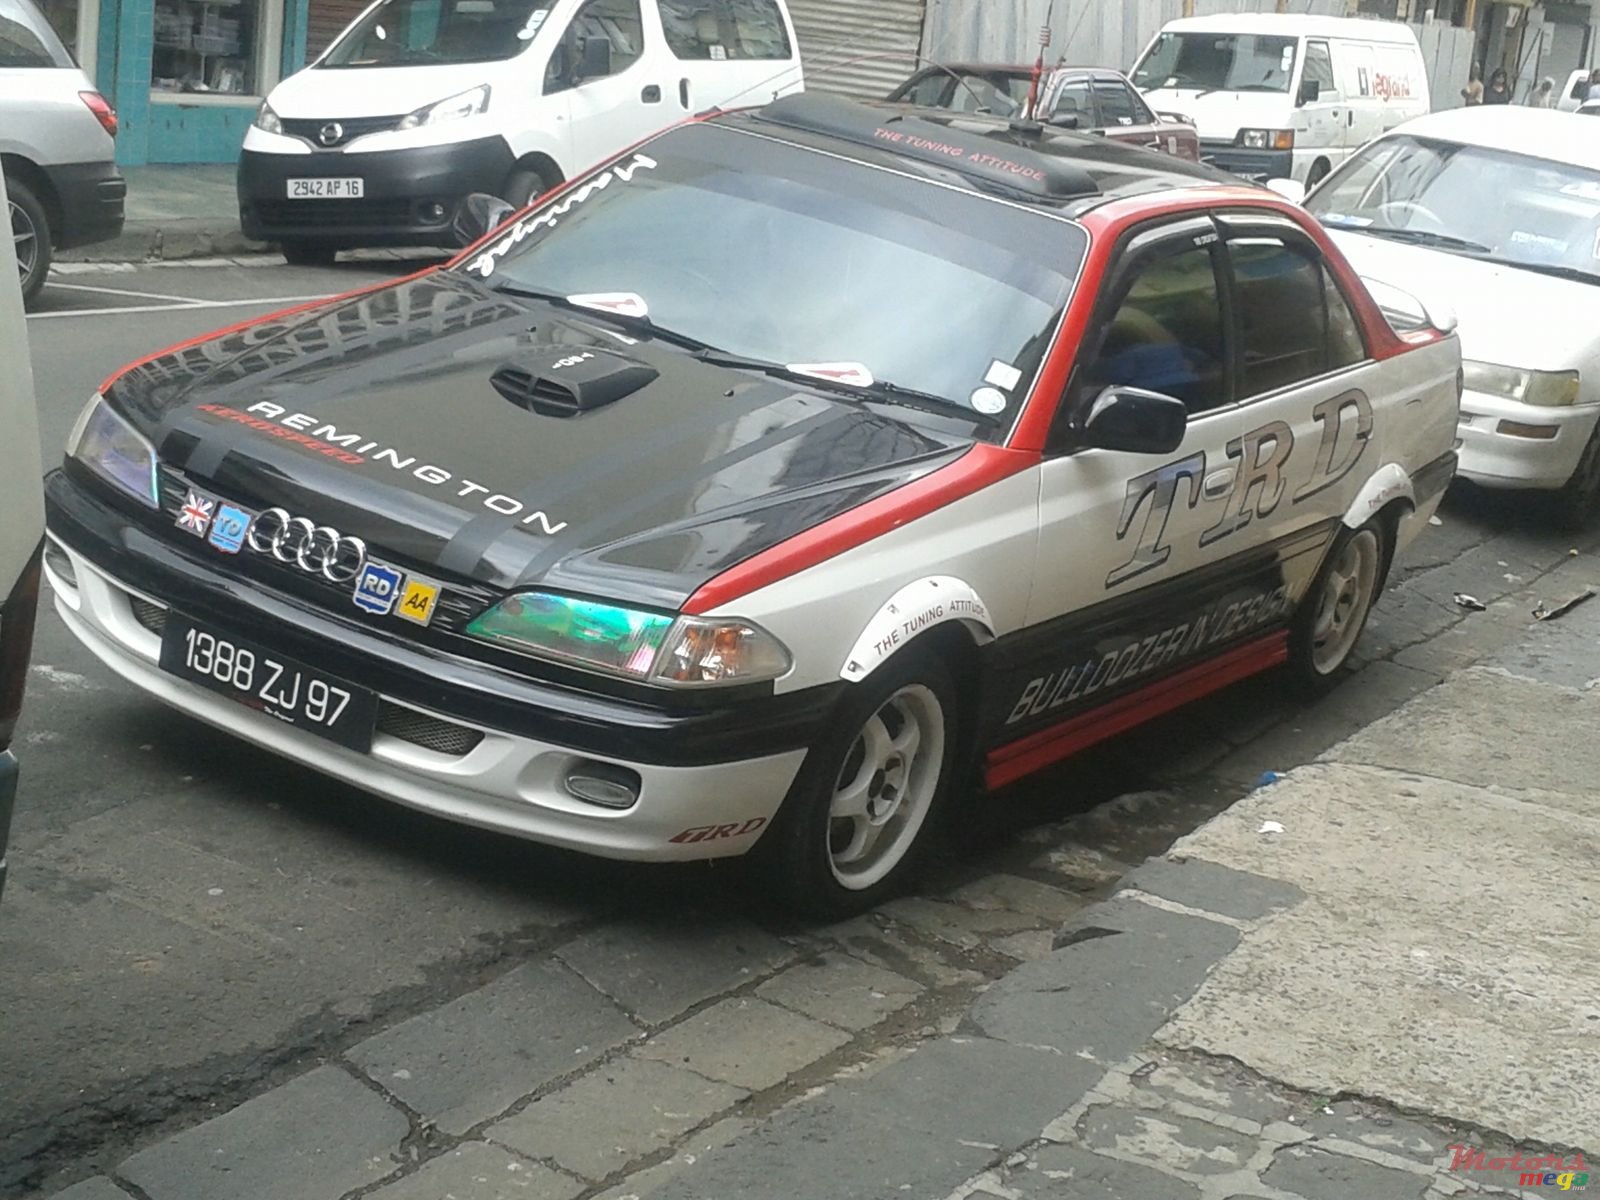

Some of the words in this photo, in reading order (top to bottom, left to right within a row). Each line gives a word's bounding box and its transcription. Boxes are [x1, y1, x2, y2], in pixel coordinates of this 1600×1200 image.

[873, 127, 901, 142] THE
[905, 135, 964, 156] TUNING
[968, 152, 1047, 181] ATTITUDE
[293, 181, 323, 196] 2942
[326, 181, 341, 195] AP
[345, 180, 359, 195] 16
[246, 401, 568, 535] REMINGTON
[1104, 387, 1374, 590] TRD
[363, 573, 392, 597] RD
[404, 592, 429, 613] AA
[873, 629, 901, 656] THE
[902, 605, 944, 635] TUNING
[949, 599, 987, 619] ATTITUDE
[185, 628, 256, 691] 1388
[259, 659, 301, 710] ZJ
[305, 680, 351, 727] 97
[1005, 623, 1190, 725] BULLDOZER
[668, 816, 769, 844] TRD
